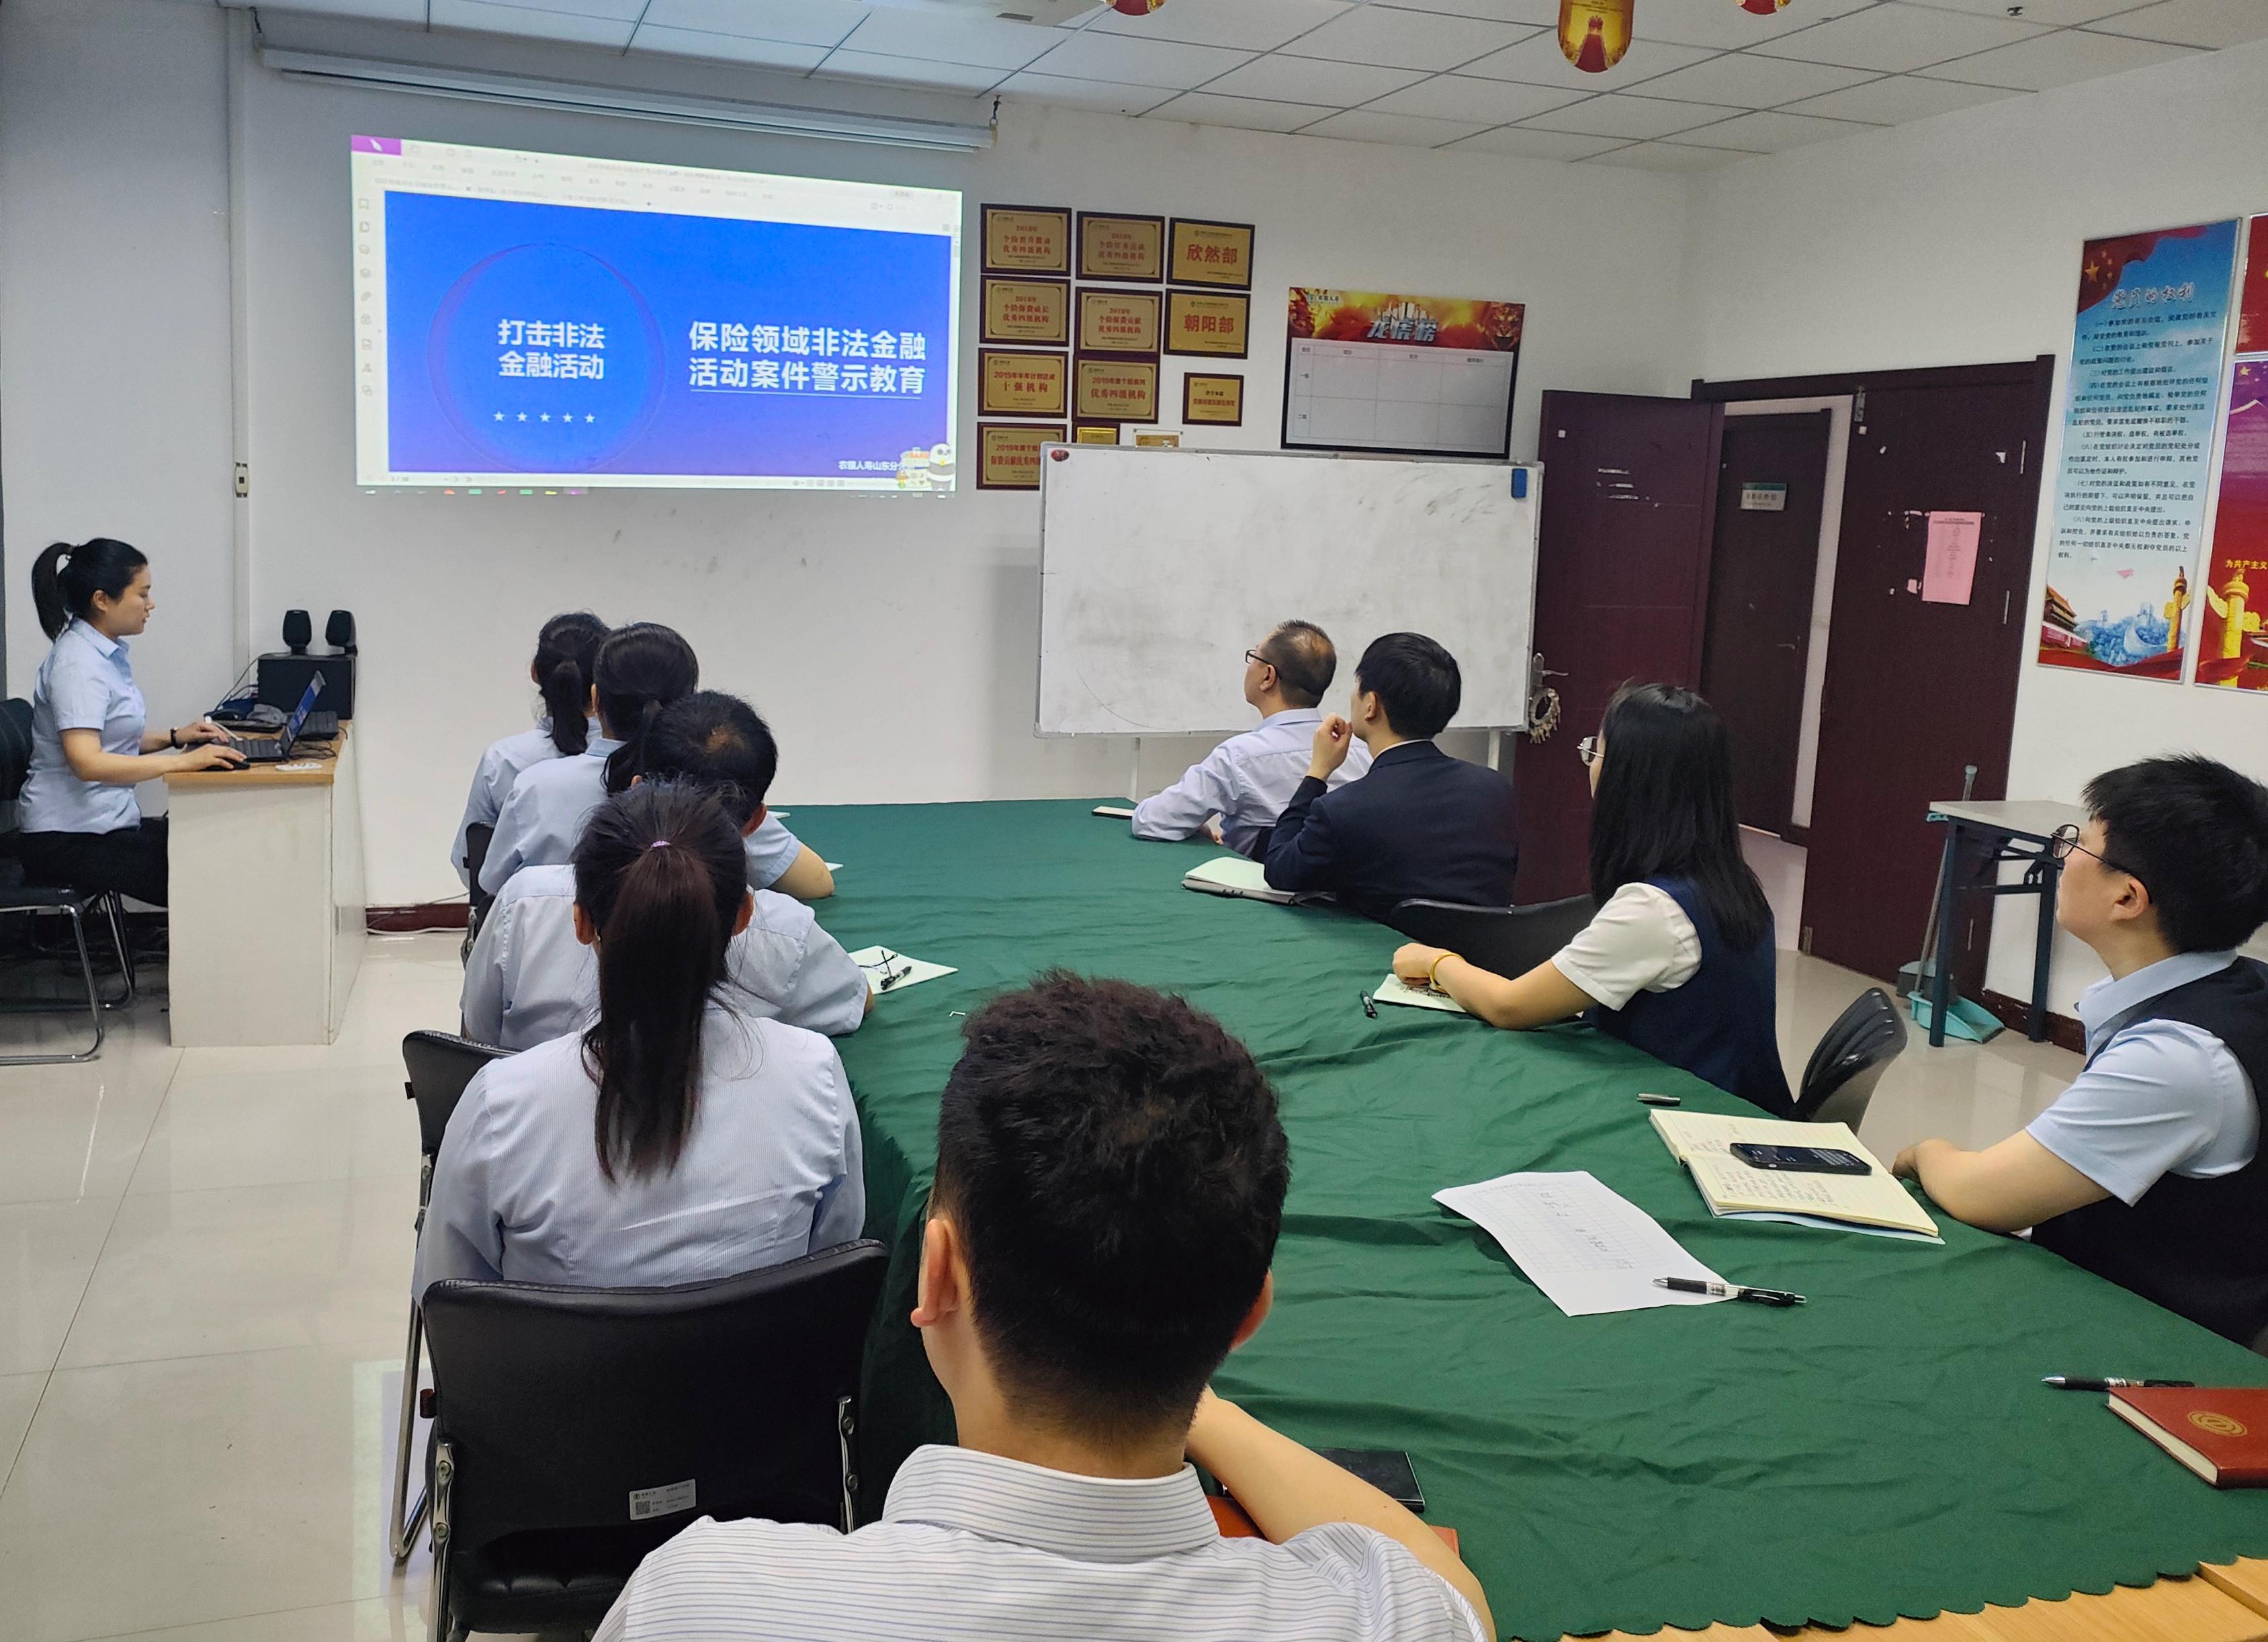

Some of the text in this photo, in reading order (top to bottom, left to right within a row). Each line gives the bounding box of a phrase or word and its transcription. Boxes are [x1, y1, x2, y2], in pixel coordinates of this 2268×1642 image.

[1186, 243, 1238, 265] 欣然部
[498, 319, 606, 350] 打击非法
[1183, 314, 1235, 335] 朝阳部
[689, 319, 927, 361] 保险领域非法金融
[498, 352, 606, 380] 金融活动
[689, 357, 926, 394] 活动案件警示教育
[1002, 381, 1048, 393] 十强机构
[1090, 388, 1146, 400] 优秀四级机构
[996, 444, 1041, 452] 2019年度个险
[2226, 559, 2268, 570] 为共产主义
